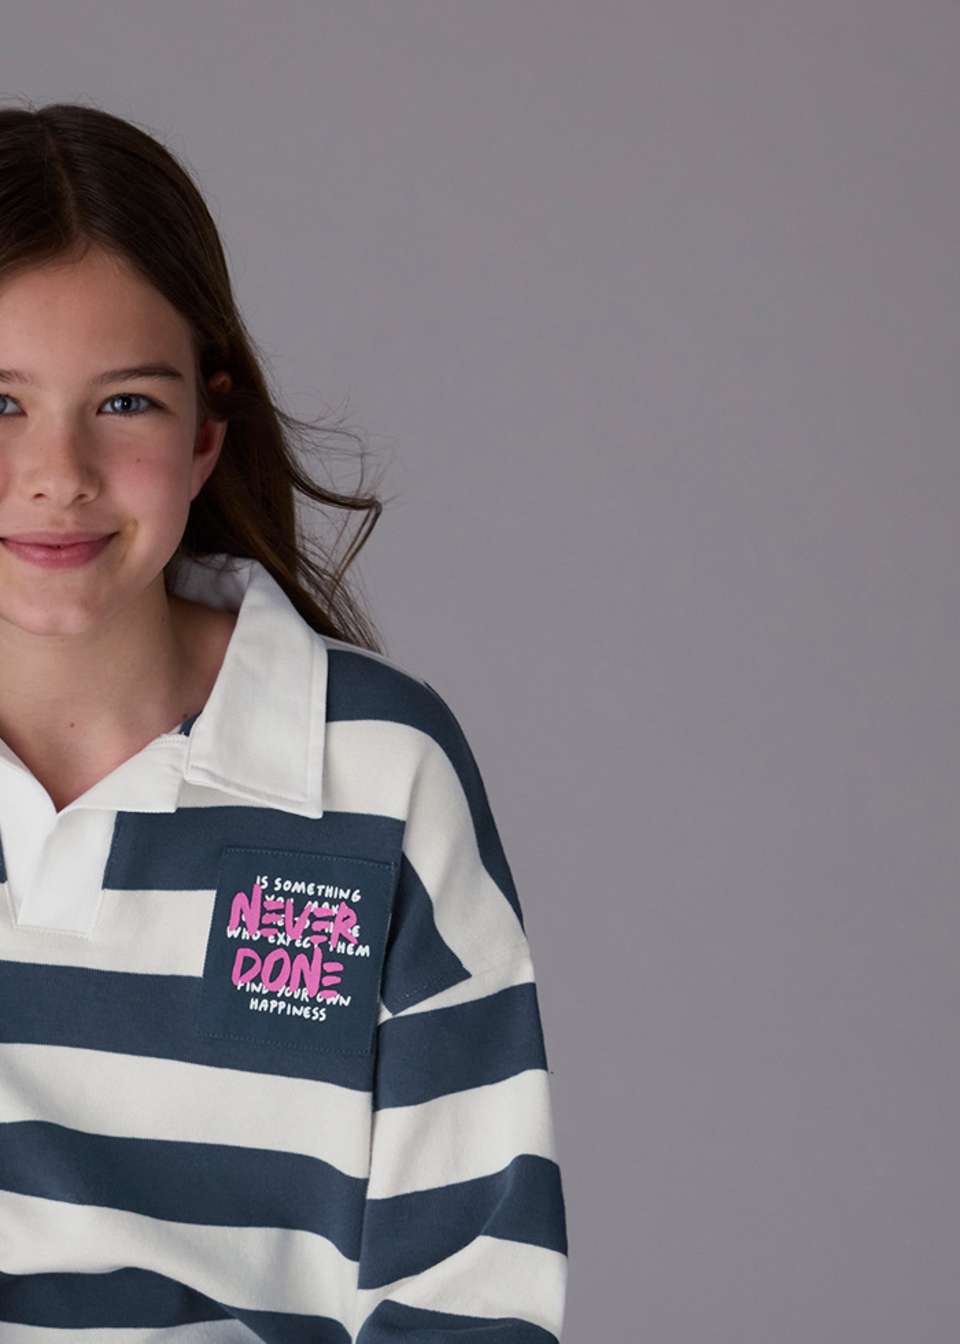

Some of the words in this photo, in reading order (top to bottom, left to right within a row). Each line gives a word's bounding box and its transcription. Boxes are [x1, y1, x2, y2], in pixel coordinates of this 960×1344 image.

[256, 875, 269, 889] IS
[274, 877, 361, 903] SOMETHING
[229, 883, 358, 948] NEVER
[268, 931, 319, 949] EXPEC
[231, 947, 344, 998] DONE
[249, 997, 327, 1021] HAPPINESS
